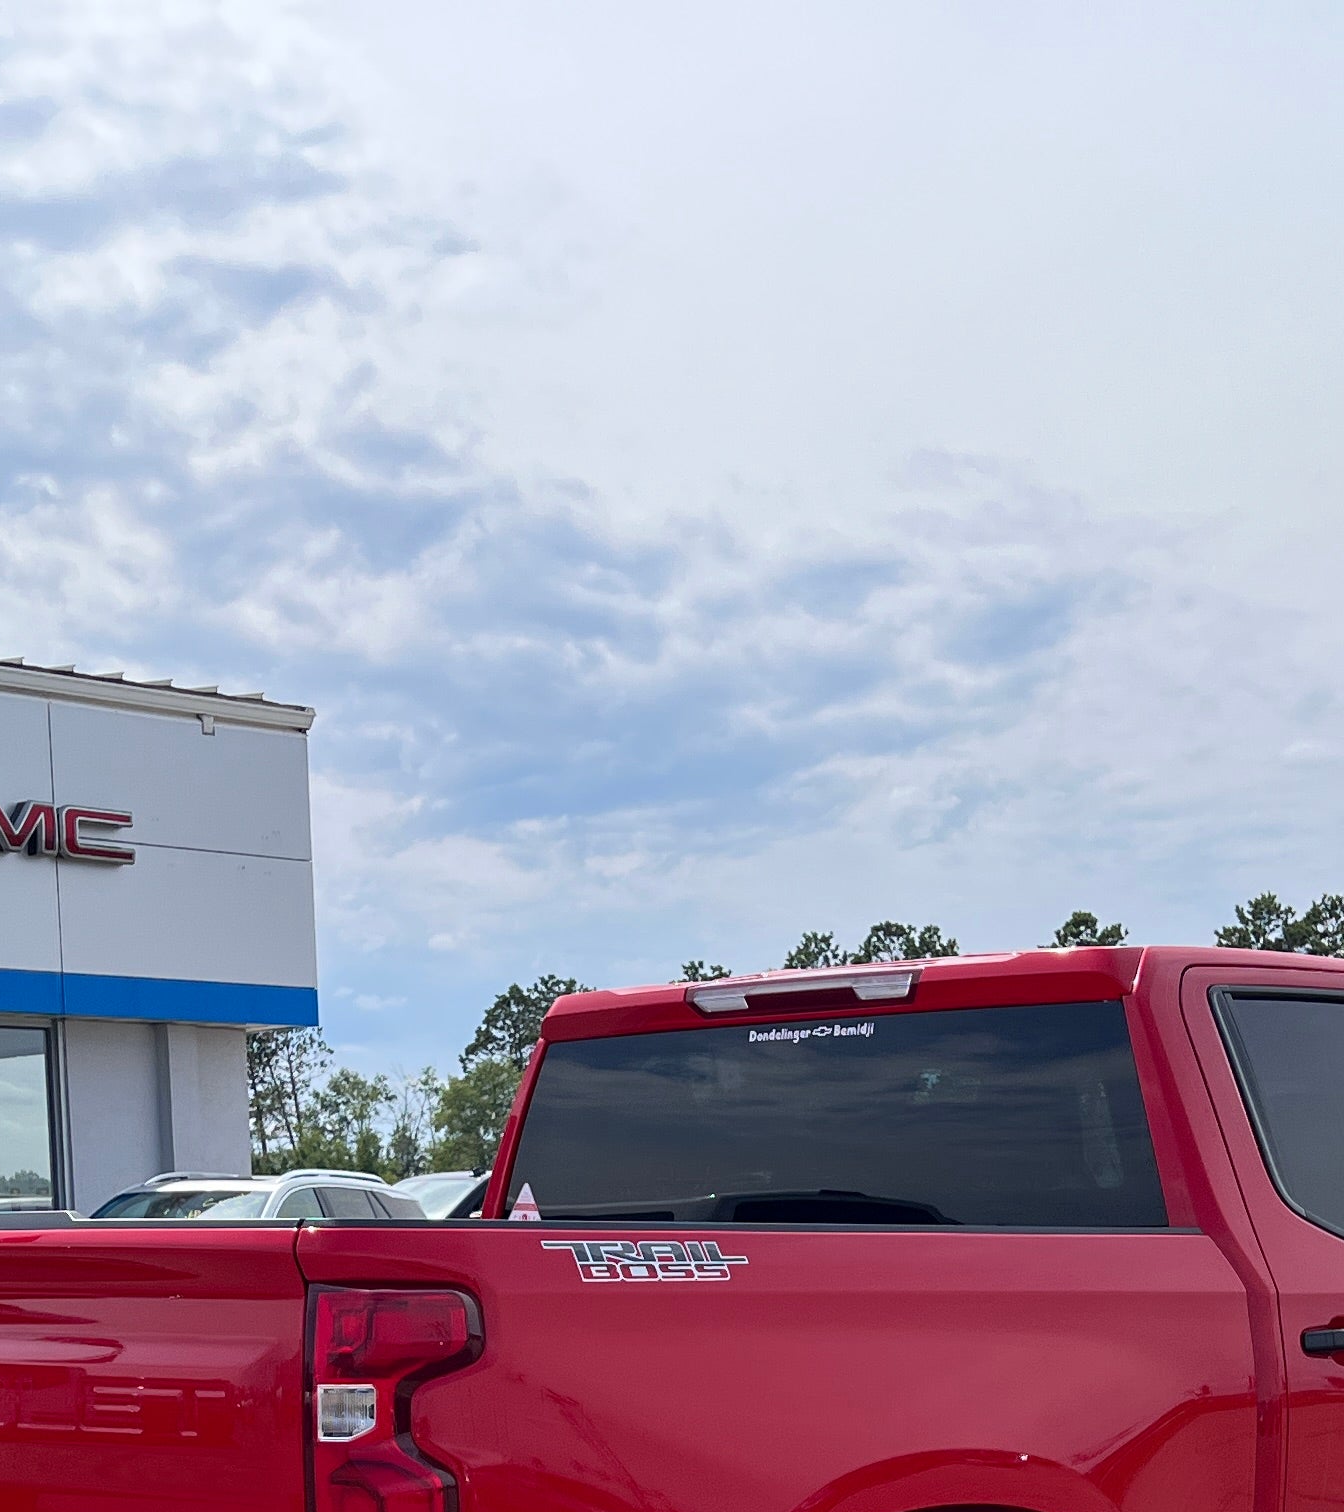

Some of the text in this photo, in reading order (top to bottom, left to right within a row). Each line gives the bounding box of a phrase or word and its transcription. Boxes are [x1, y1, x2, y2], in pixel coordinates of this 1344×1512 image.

[749, 1022, 875, 1043] Dondelinger Bemidji
[541, 1240, 749, 1264] TRAIL
[579, 1262, 731, 1283] BOSS
